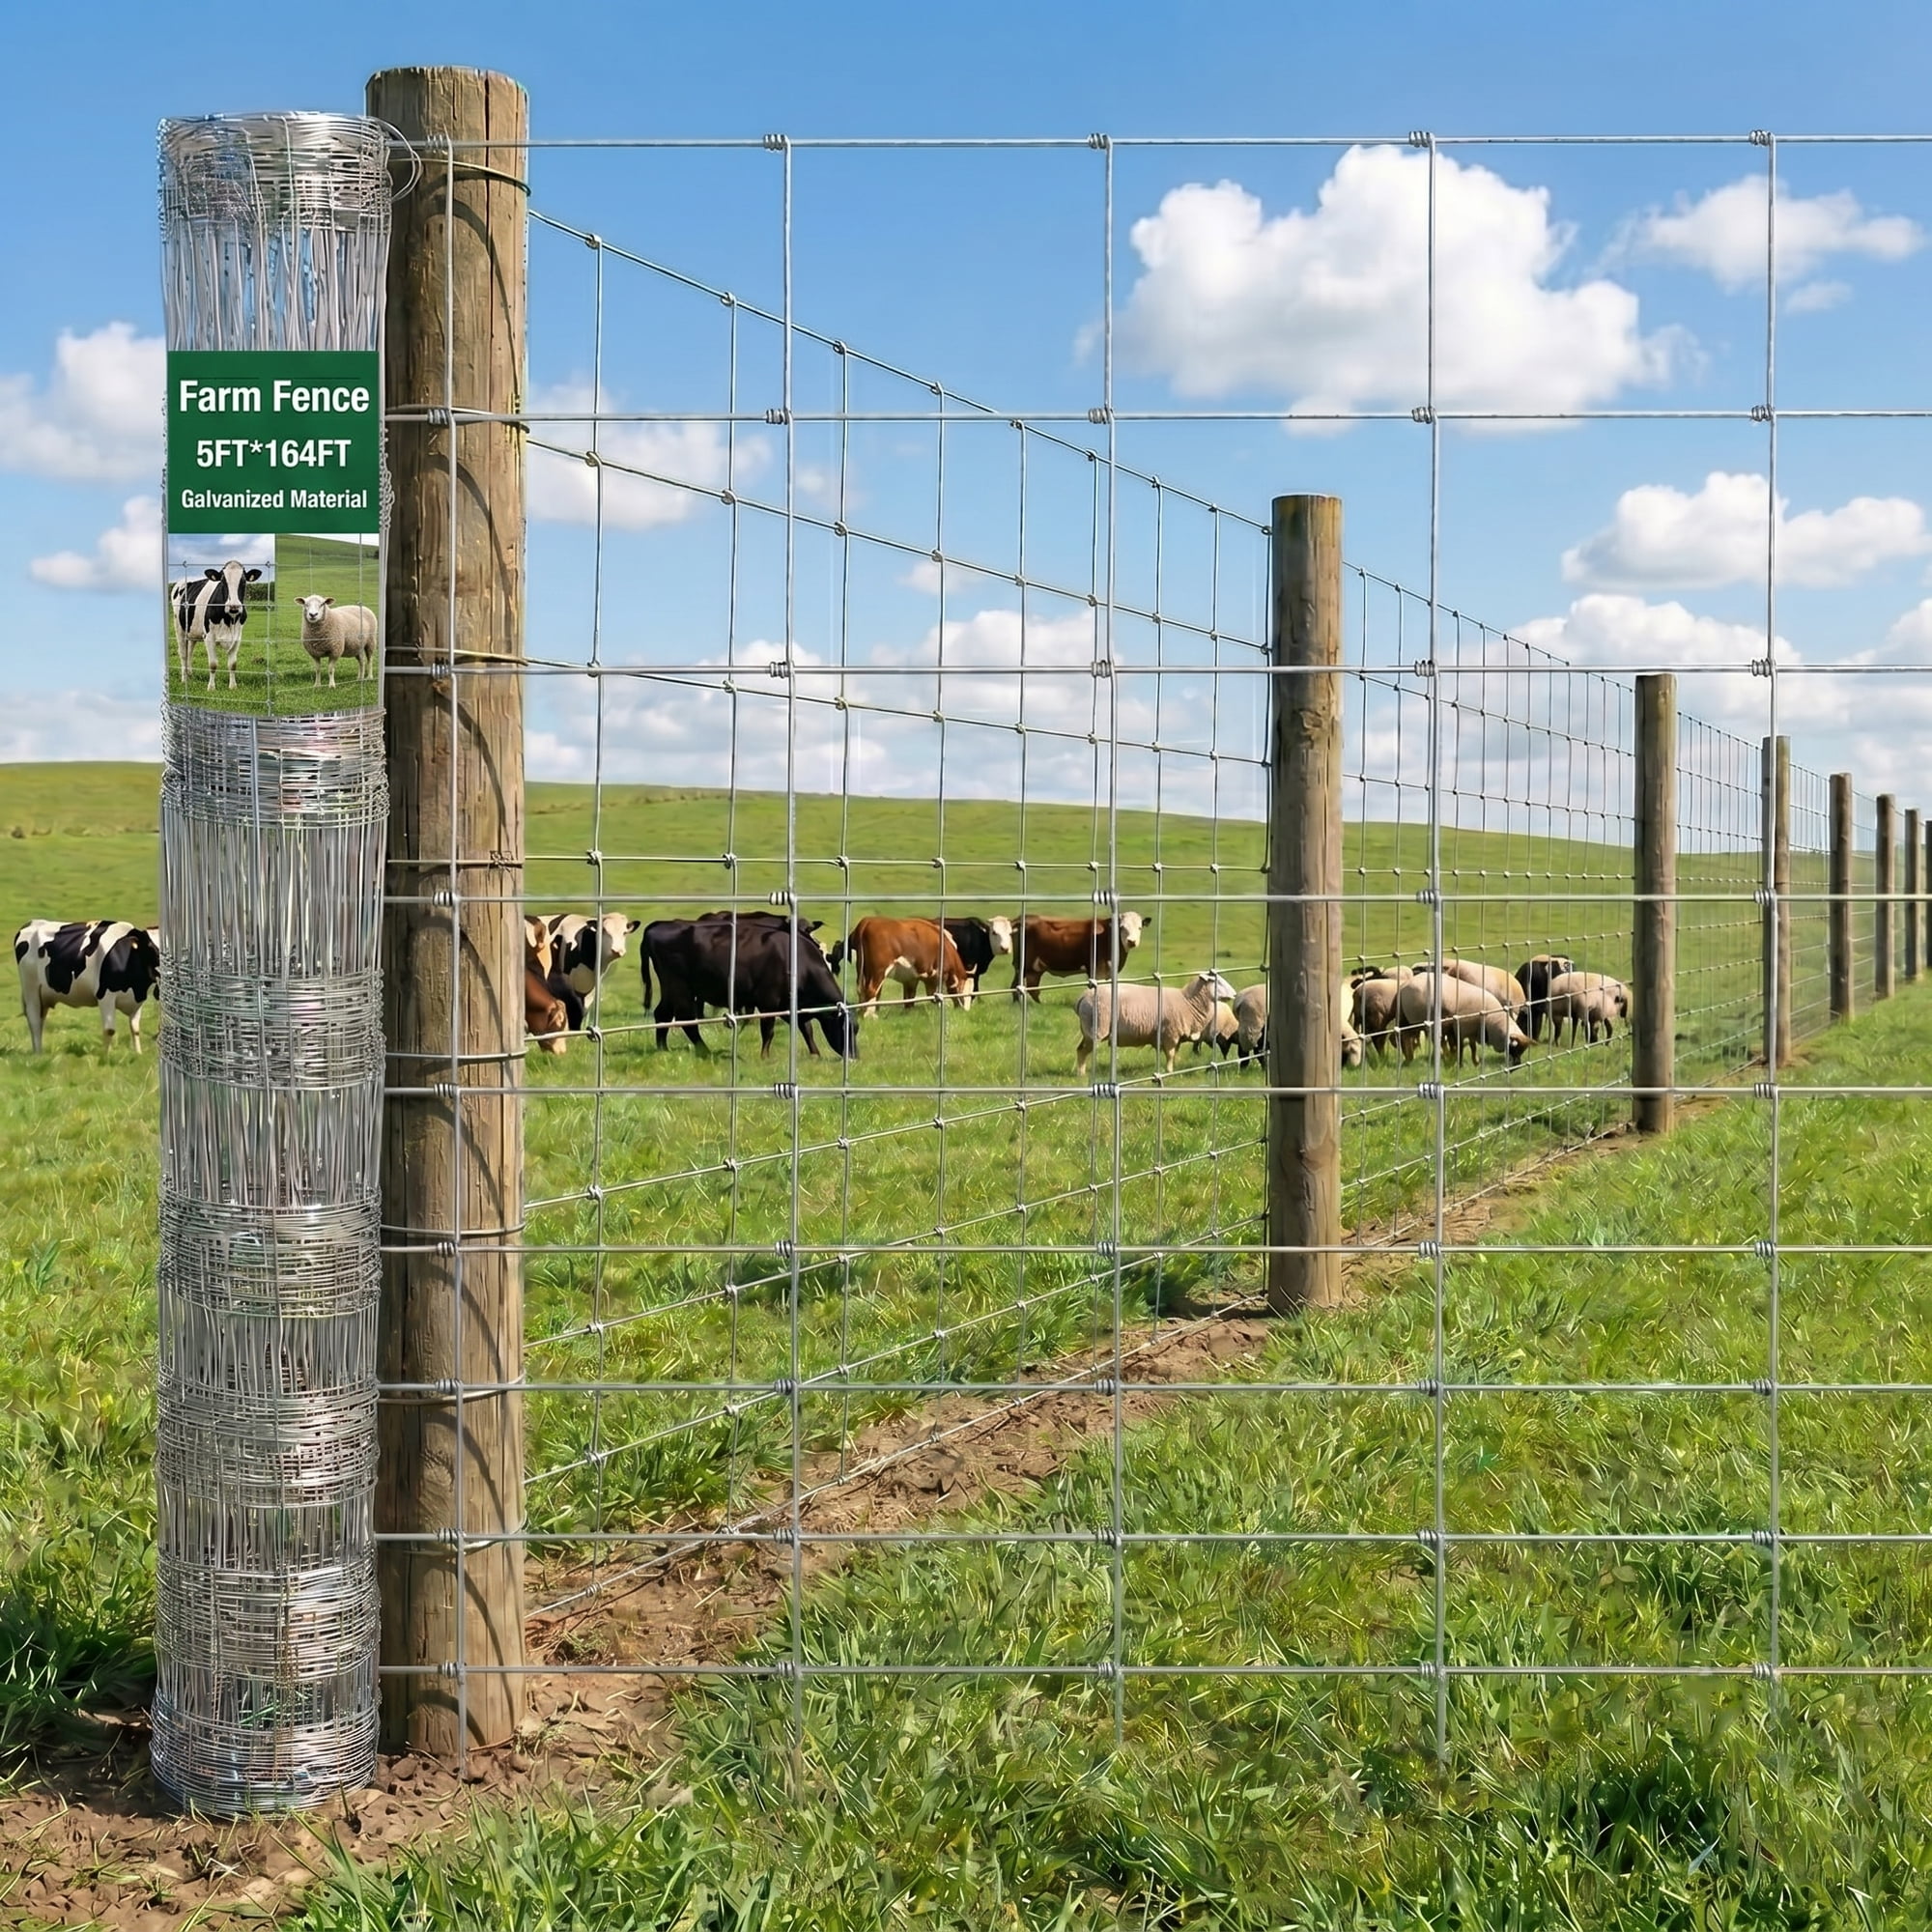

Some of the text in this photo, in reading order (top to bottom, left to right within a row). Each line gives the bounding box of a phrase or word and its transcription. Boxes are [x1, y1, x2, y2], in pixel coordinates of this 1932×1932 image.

[180, 380, 369, 412] Farm Fence
[181, 489, 367, 508] Galvanized Material
